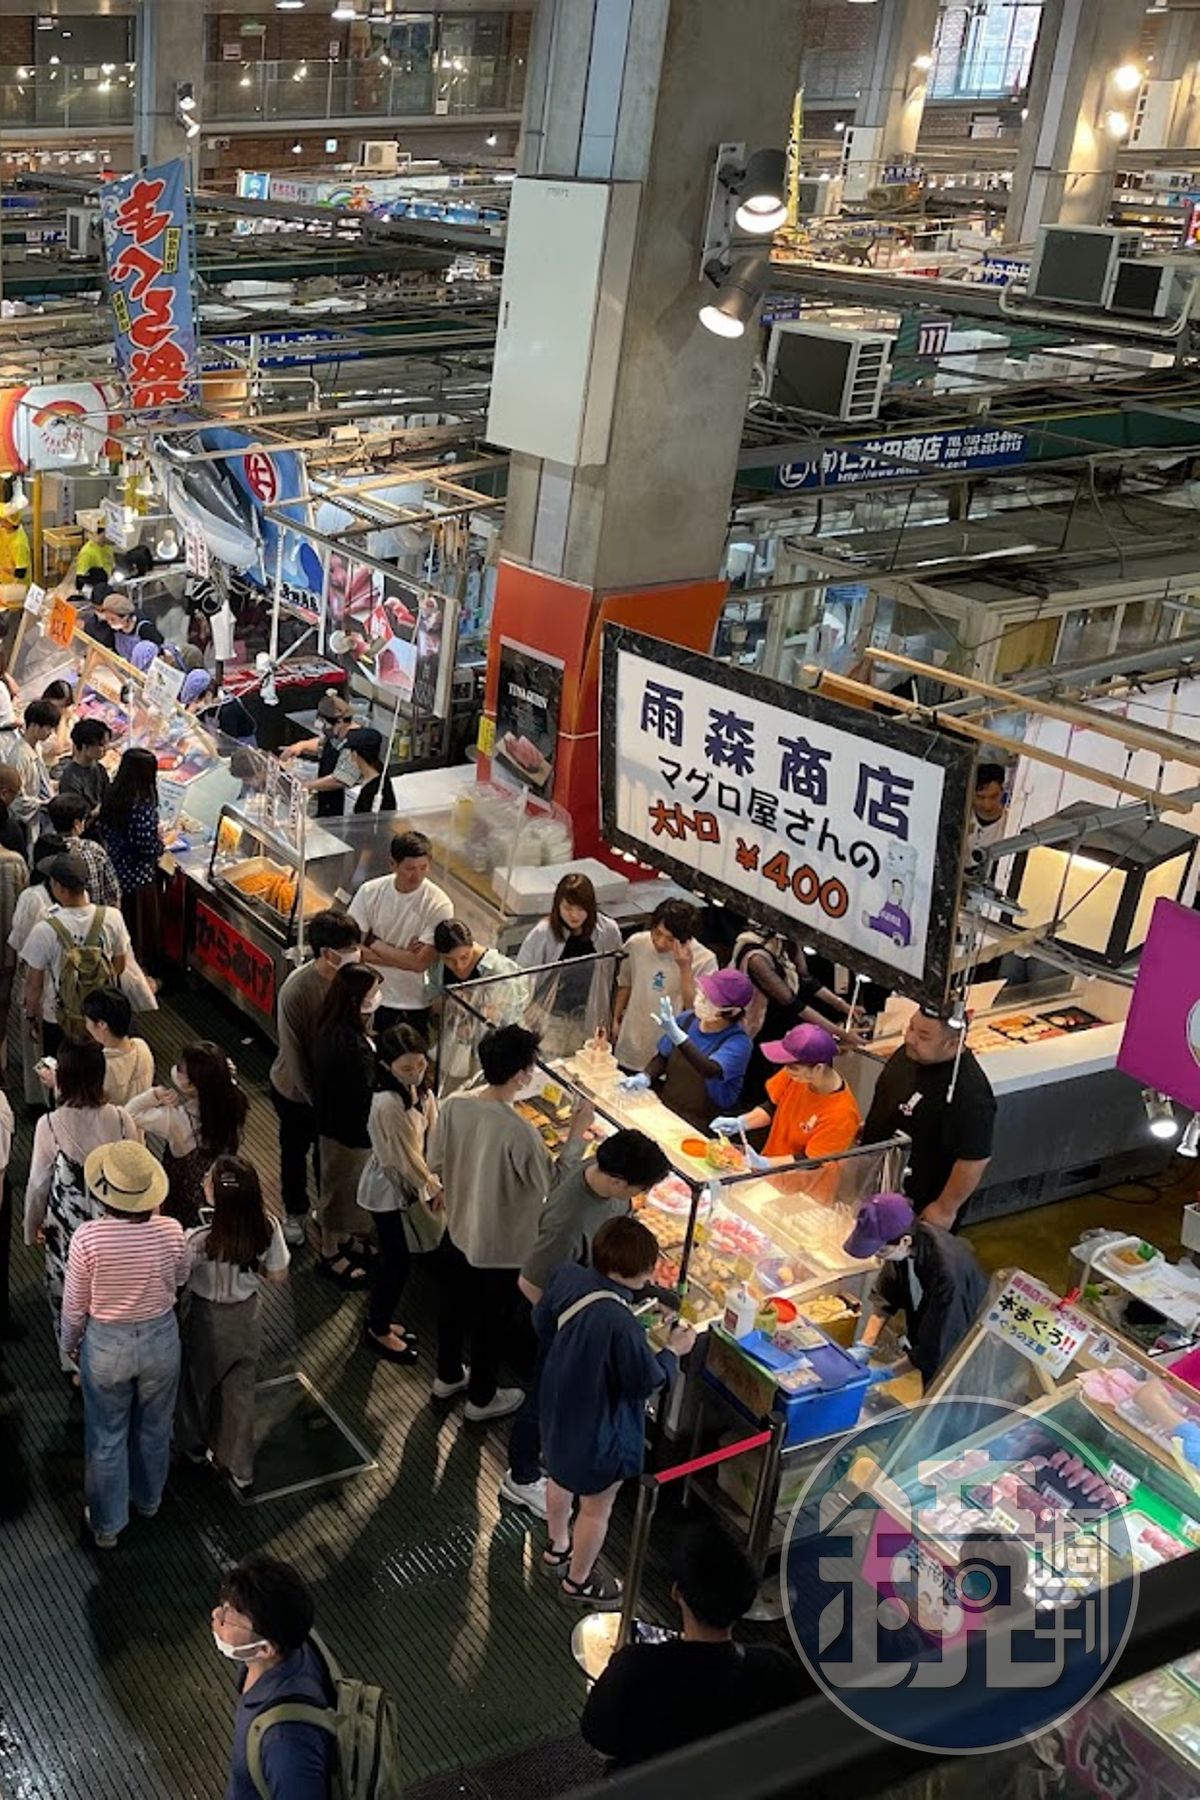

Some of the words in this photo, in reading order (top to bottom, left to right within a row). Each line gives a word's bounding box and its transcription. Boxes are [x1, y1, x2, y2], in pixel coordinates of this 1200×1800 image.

[640, 679, 915, 842] 雨森商店
[658, 755, 881, 879] マグロ屋さんの
